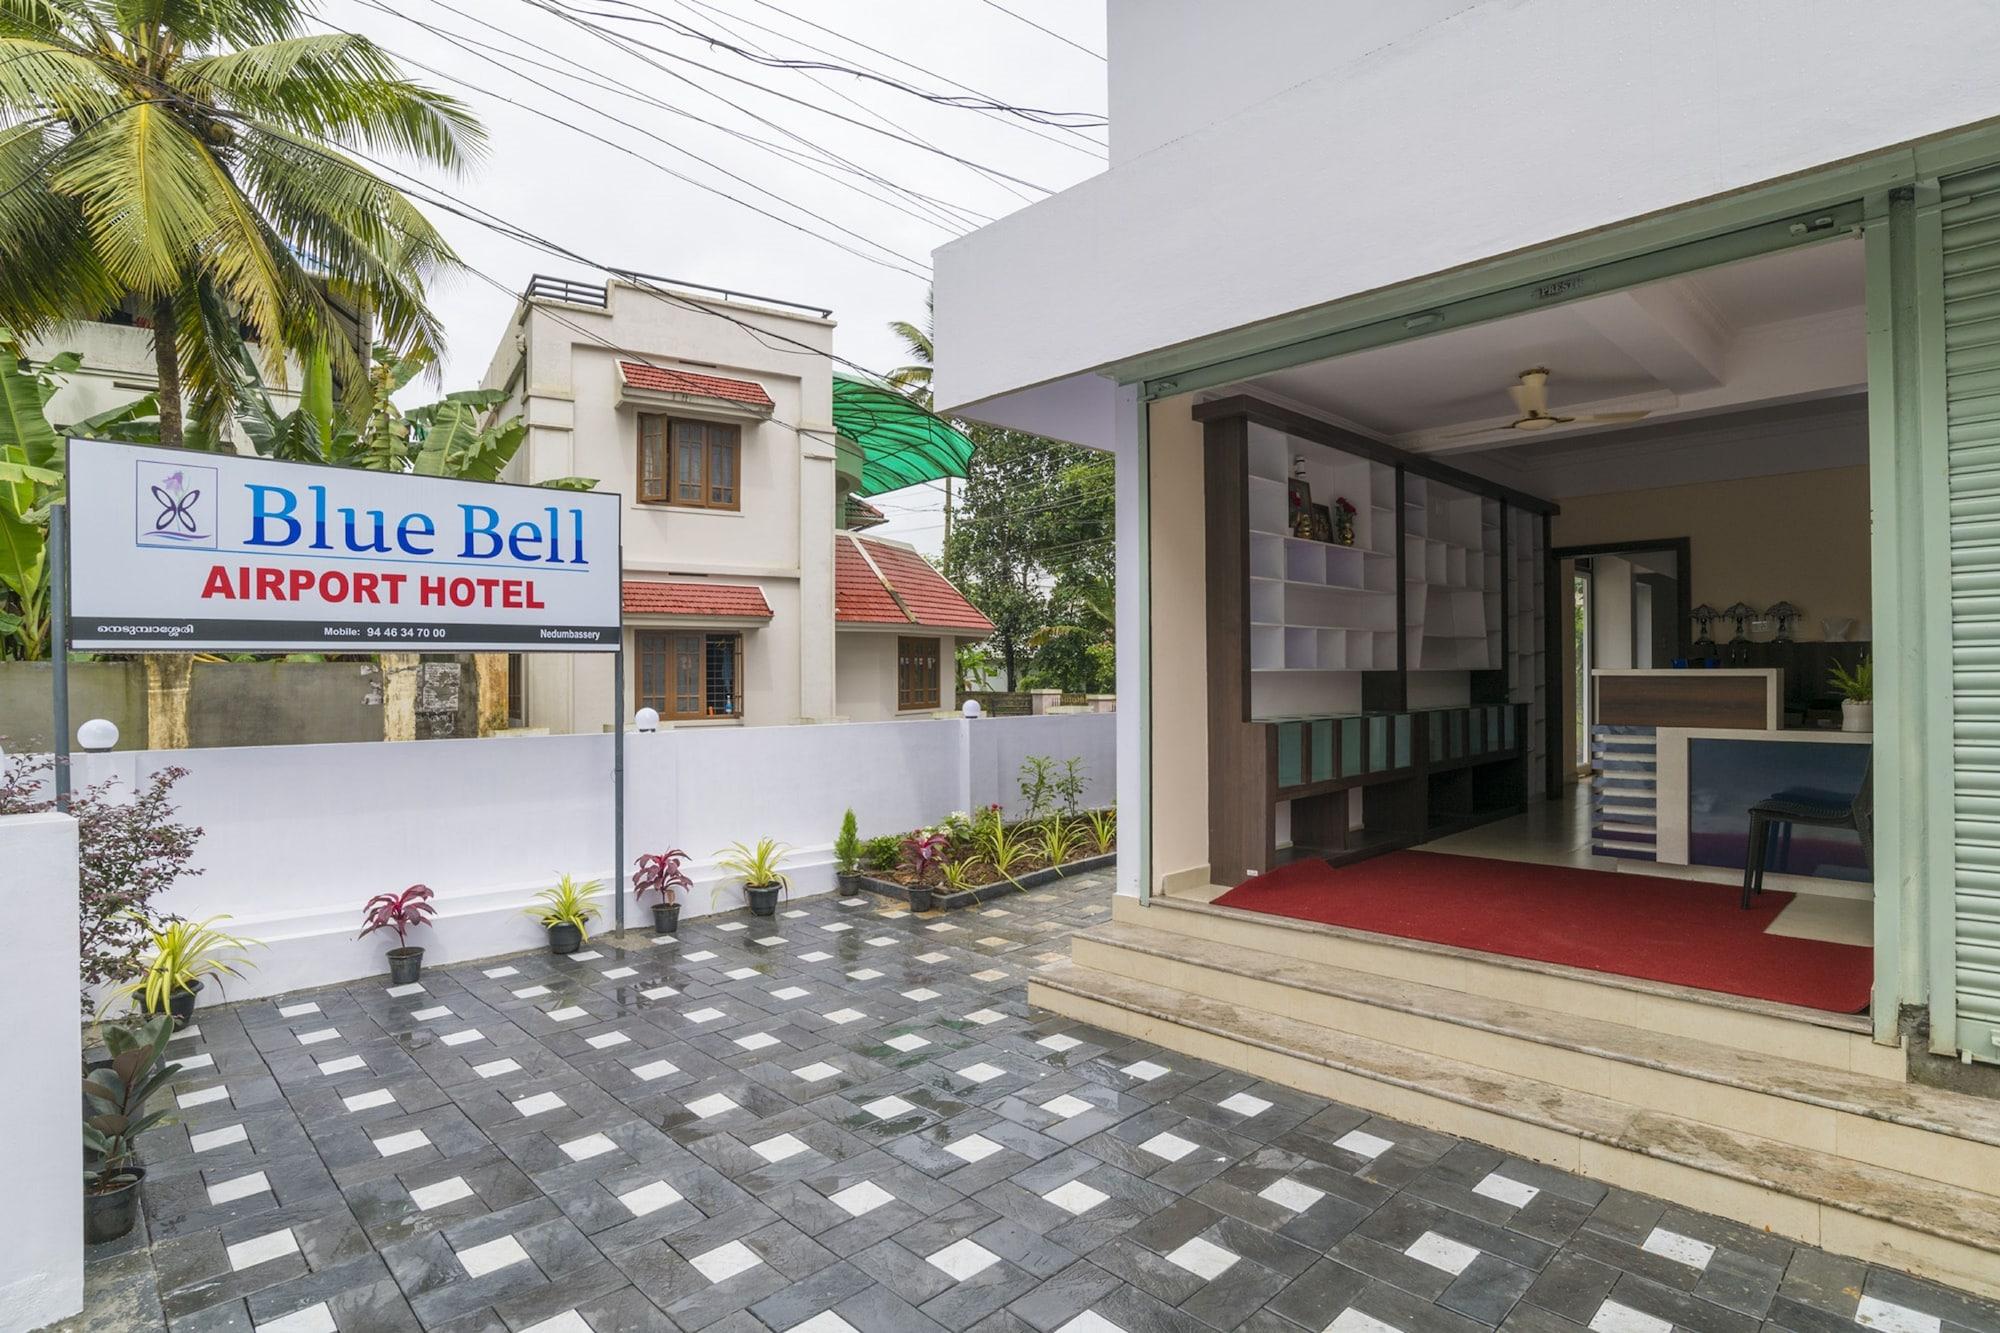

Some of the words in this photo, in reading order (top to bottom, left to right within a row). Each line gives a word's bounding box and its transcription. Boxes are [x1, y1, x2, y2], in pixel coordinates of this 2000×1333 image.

[243, 483, 435, 555] Blue
[457, 504, 590, 564] Bell
[201, 565, 407, 604] AIRPORT
[420, 576, 545, 609] HOTEL
[324, 627, 361, 636] Mobile:
[366, 627, 381, 637] 94
[383, 627, 398, 637] 46
[400, 628, 414, 637] 34
[417, 628, 430, 638] 70
[432, 628, 446, 638] 00
[540, 629, 600, 641] Nedumbassery
